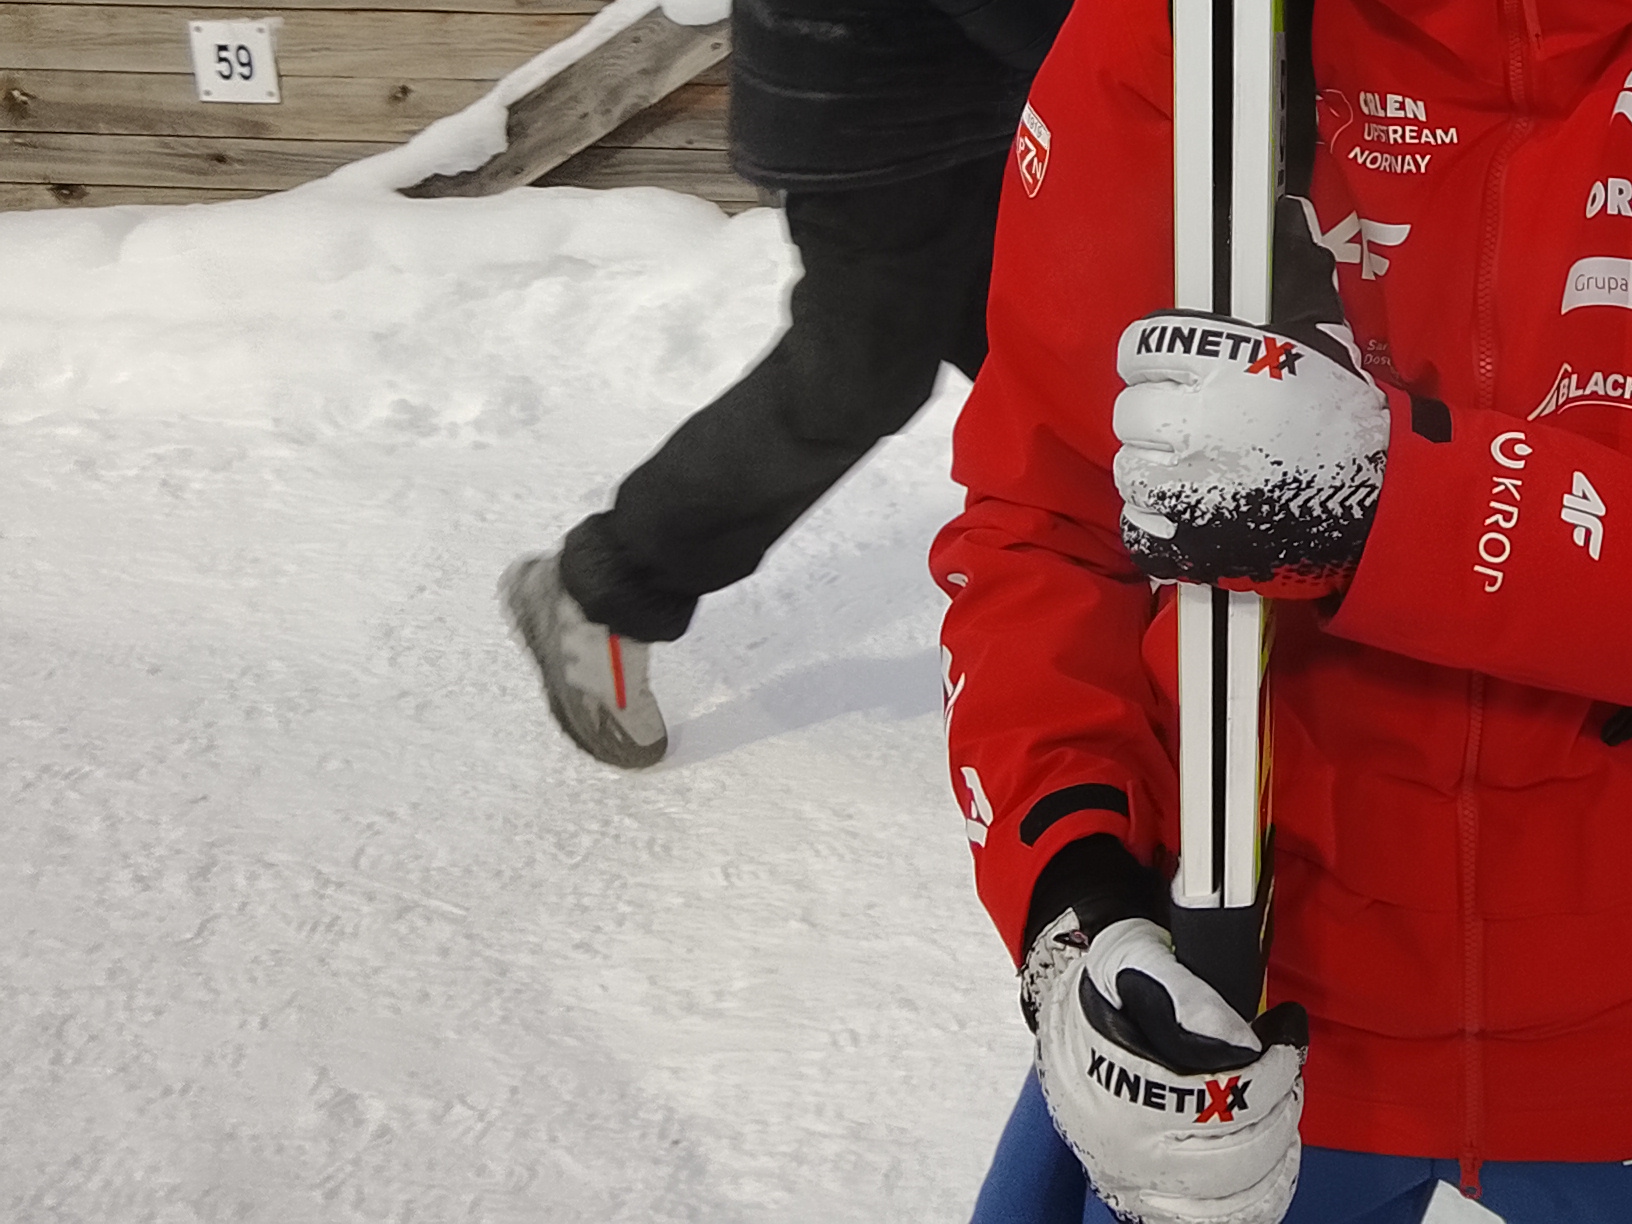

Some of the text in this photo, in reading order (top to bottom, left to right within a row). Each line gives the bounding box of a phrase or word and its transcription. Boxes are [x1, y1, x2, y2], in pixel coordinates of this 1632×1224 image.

[215, 44, 254, 81] 59
[1574, 273, 1628, 295] Grupa
[1560, 470, 1607, 562] 4F
